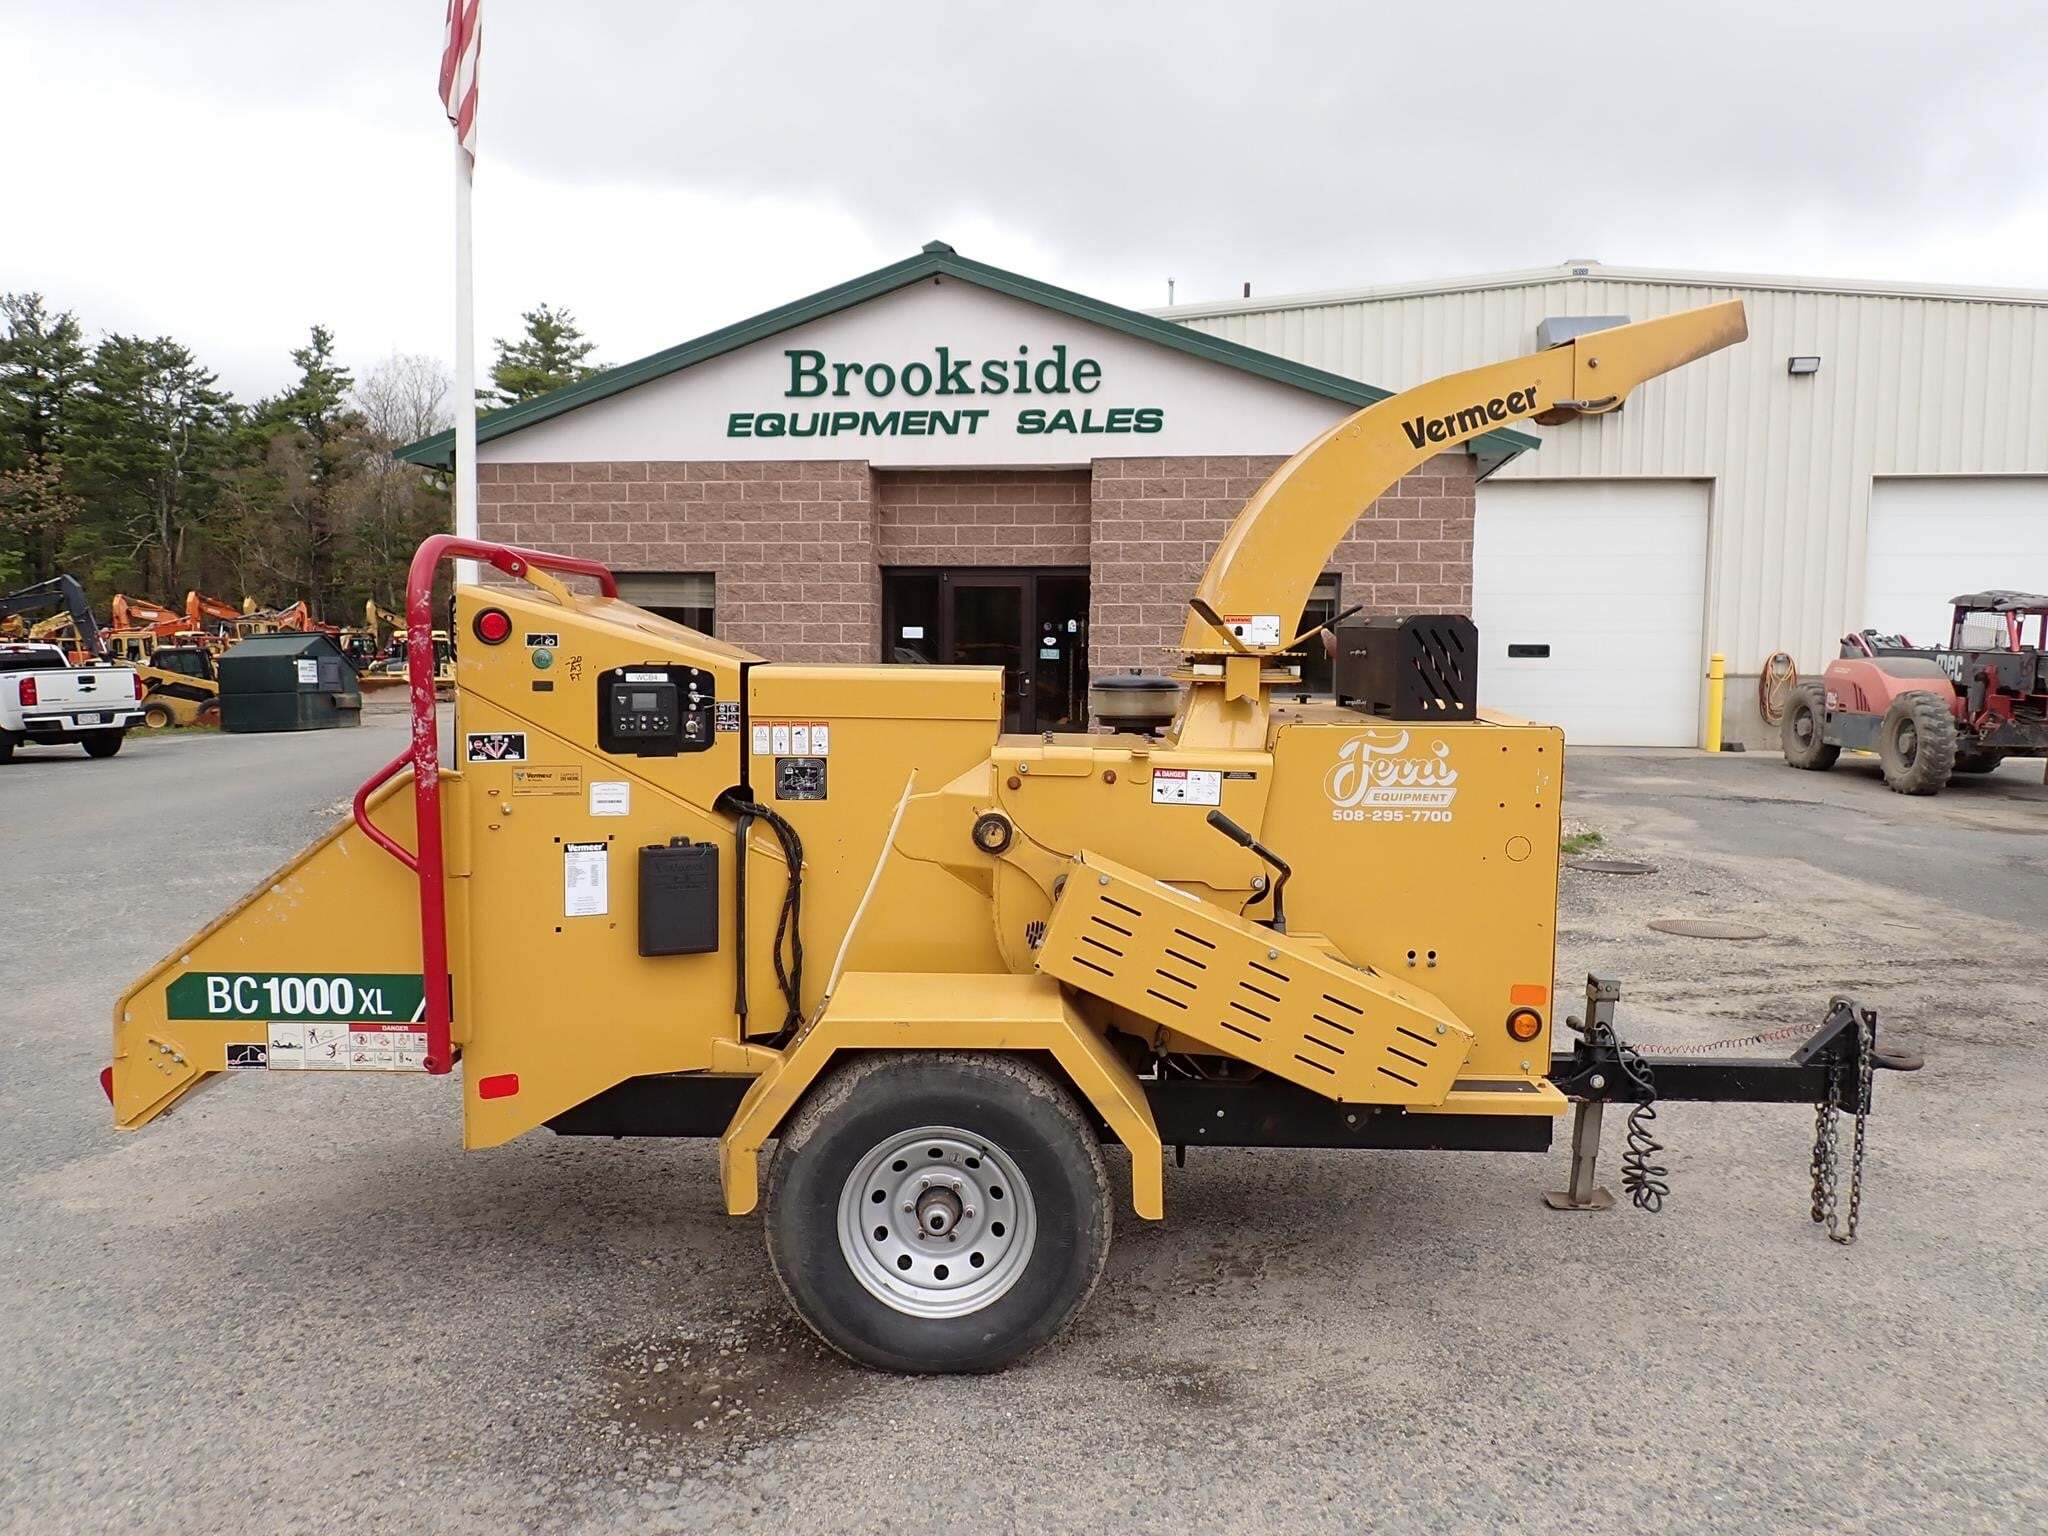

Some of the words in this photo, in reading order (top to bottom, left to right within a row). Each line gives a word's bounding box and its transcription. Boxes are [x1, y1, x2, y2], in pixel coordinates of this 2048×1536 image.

[784, 345, 1102, 398] Brookside
[726, 409, 990, 438] EQUIPMENT
[1015, 408, 1165, 434] SALES
[1401, 385, 1537, 450] Vermeer
[1161, 770, 1186, 778] DANGER
[1372, 792, 1448, 802] EQUIPMENT
[1332, 809, 1453, 822] 508-295-7700
[358, 988, 393, 1015] XL
[381, 1024, 409, 1032] DANGER
